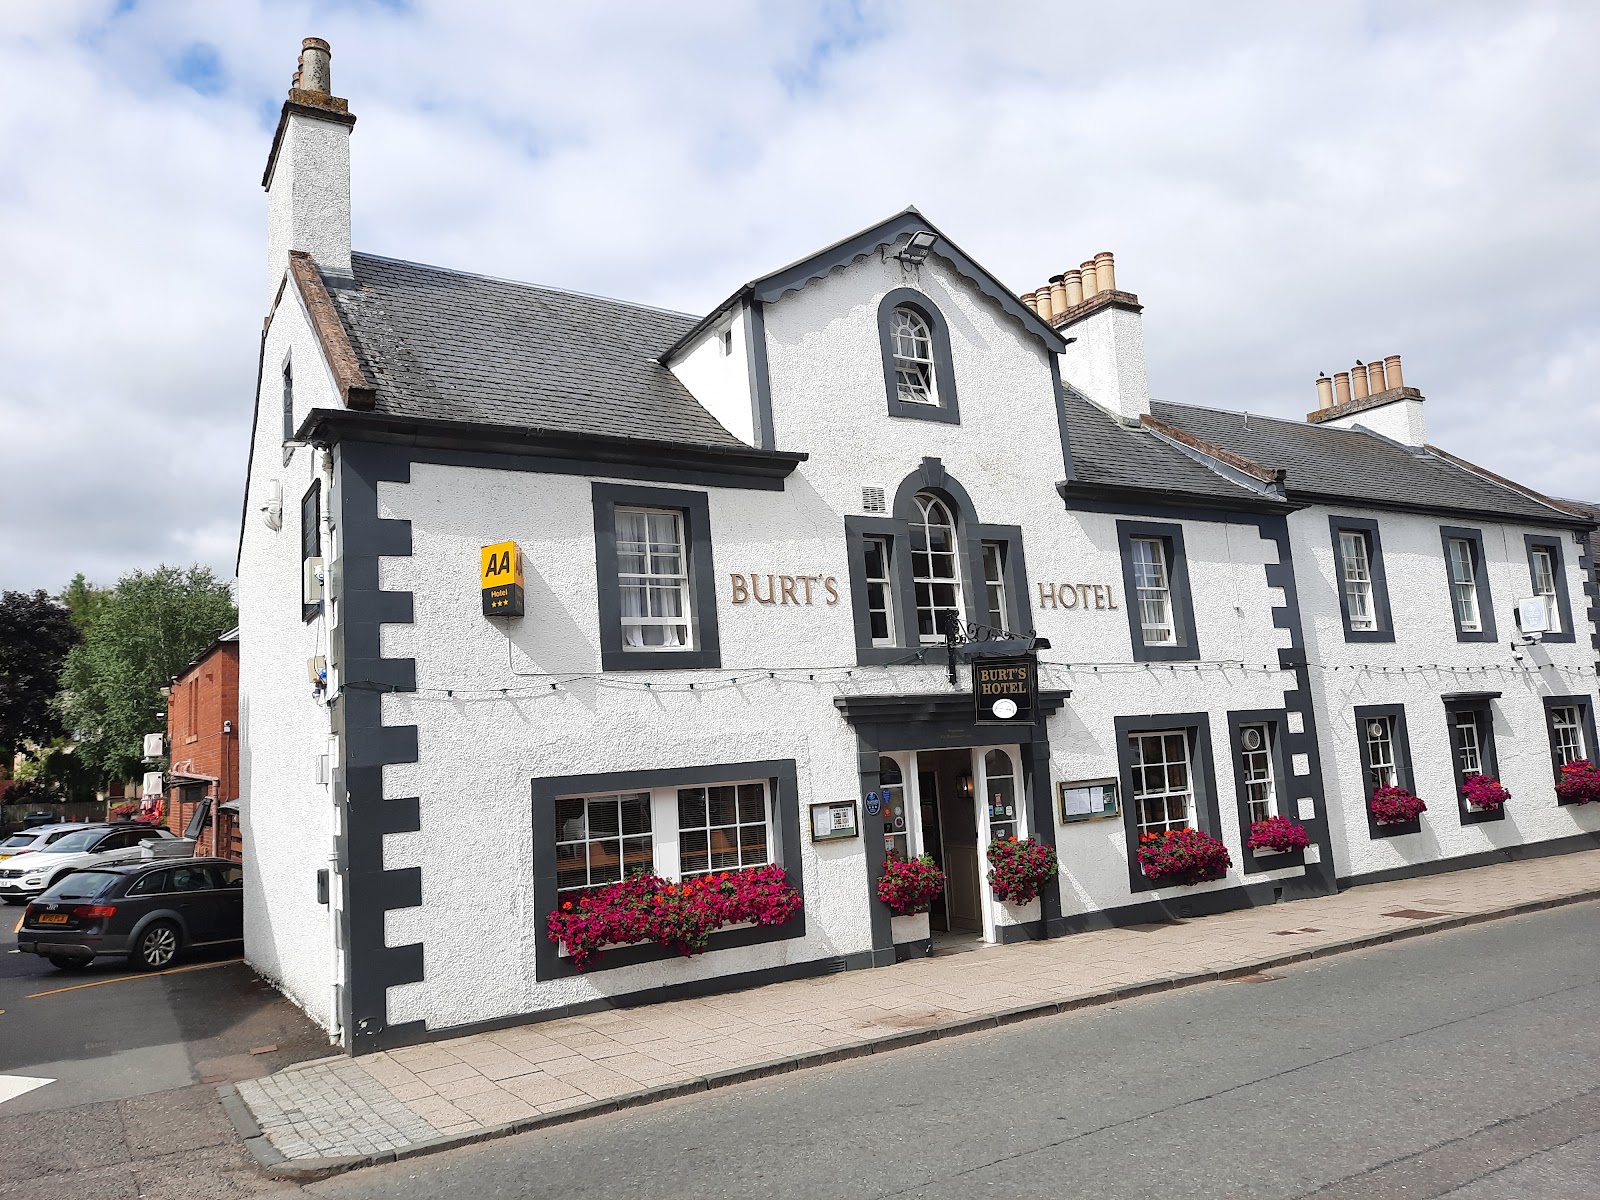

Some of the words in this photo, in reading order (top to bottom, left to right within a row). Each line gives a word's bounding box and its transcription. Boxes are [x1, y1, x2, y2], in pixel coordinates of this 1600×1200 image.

[485, 551, 510, 577] AA
[491, 588, 508, 598] Hotel
[730, 573, 839, 605] BURT'S
[1037, 582, 1118, 609] HOTEL
[980, 667, 1027, 682] BURT'S
[981, 681, 1027, 695] HOTEL
